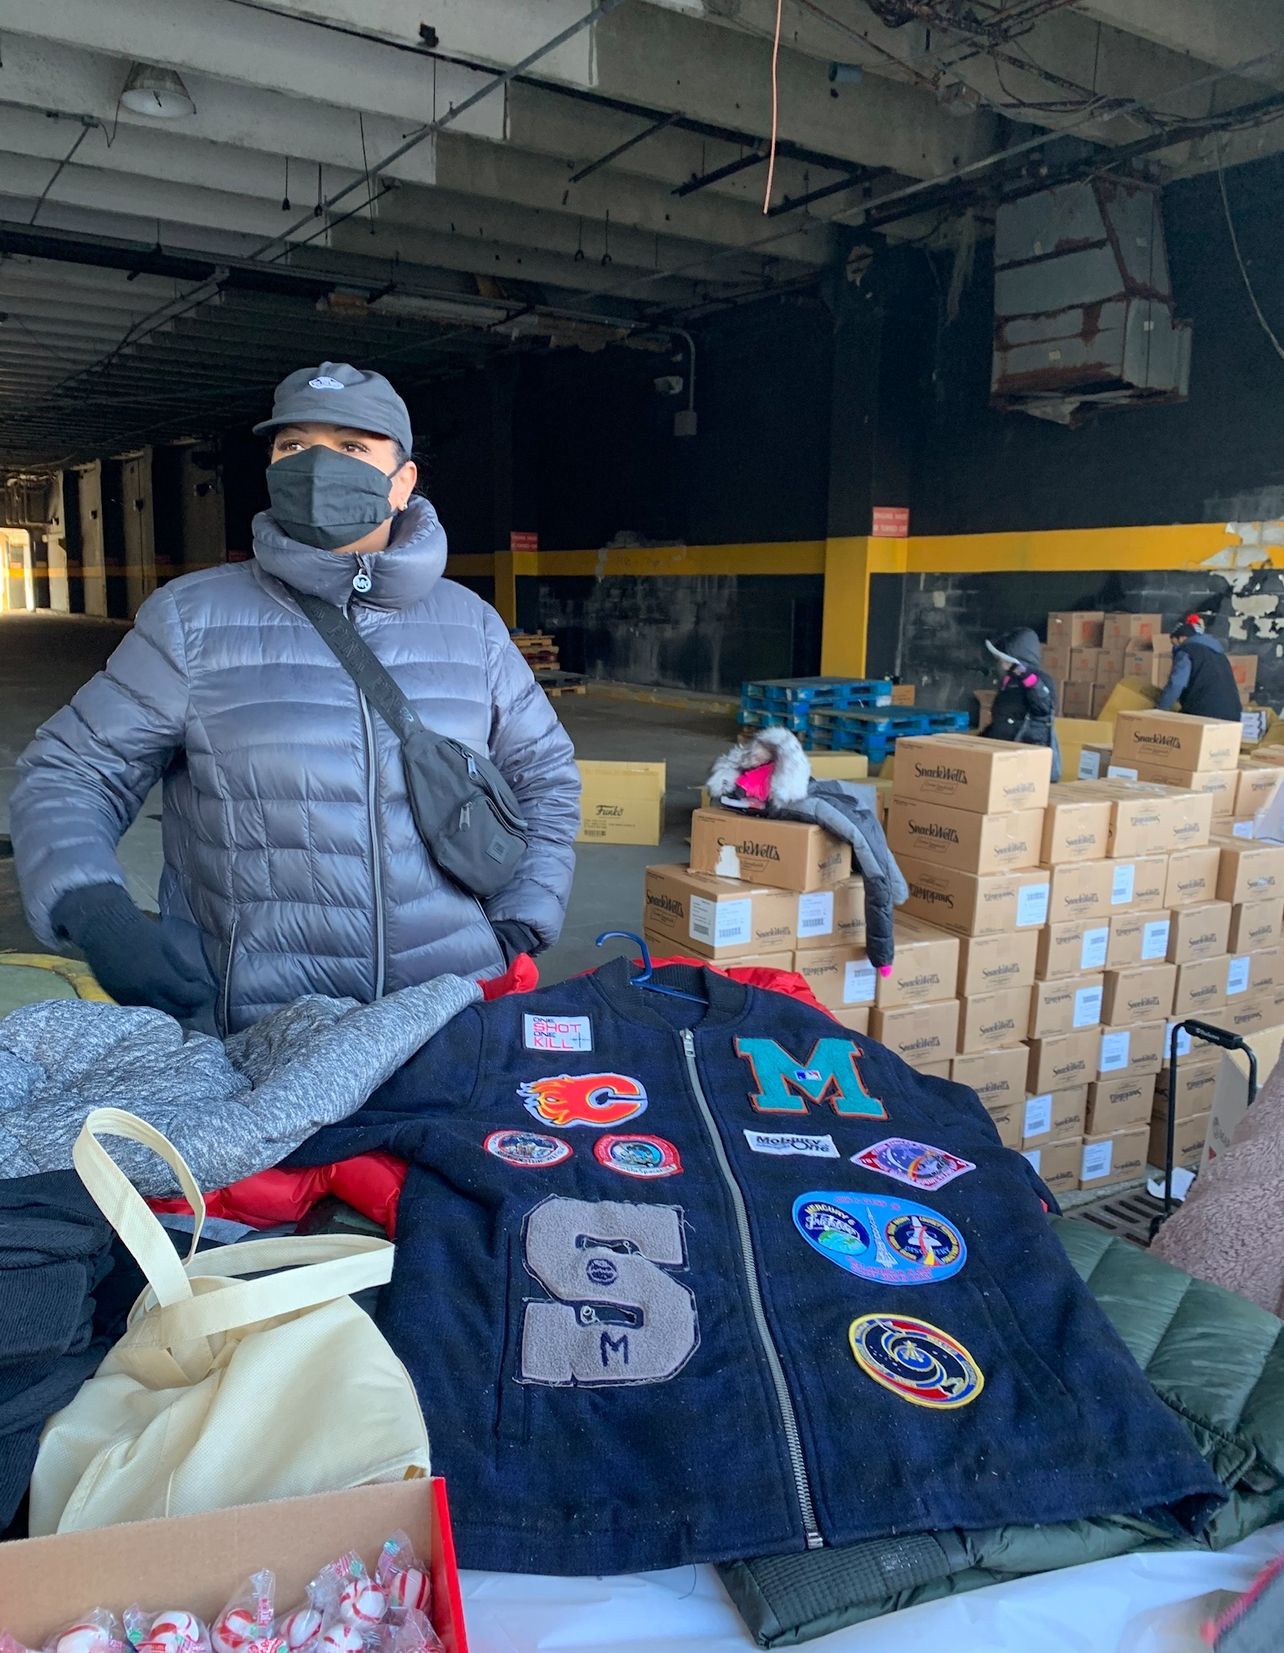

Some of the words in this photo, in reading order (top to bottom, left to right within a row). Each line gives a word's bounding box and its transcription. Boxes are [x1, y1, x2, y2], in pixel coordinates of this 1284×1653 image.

[1134, 731, 1181, 749] SnackWell's
[914, 762, 968, 784] SnackWell's
[908, 819, 959, 843] SnackWell's
[534, 1022, 581, 1033] SHOT
[534, 1037, 573, 1049] KILL
[733, 1035, 889, 1120] M
[804, 1203, 849, 1220] MERCURY
[601, 1331, 629, 1367] M
